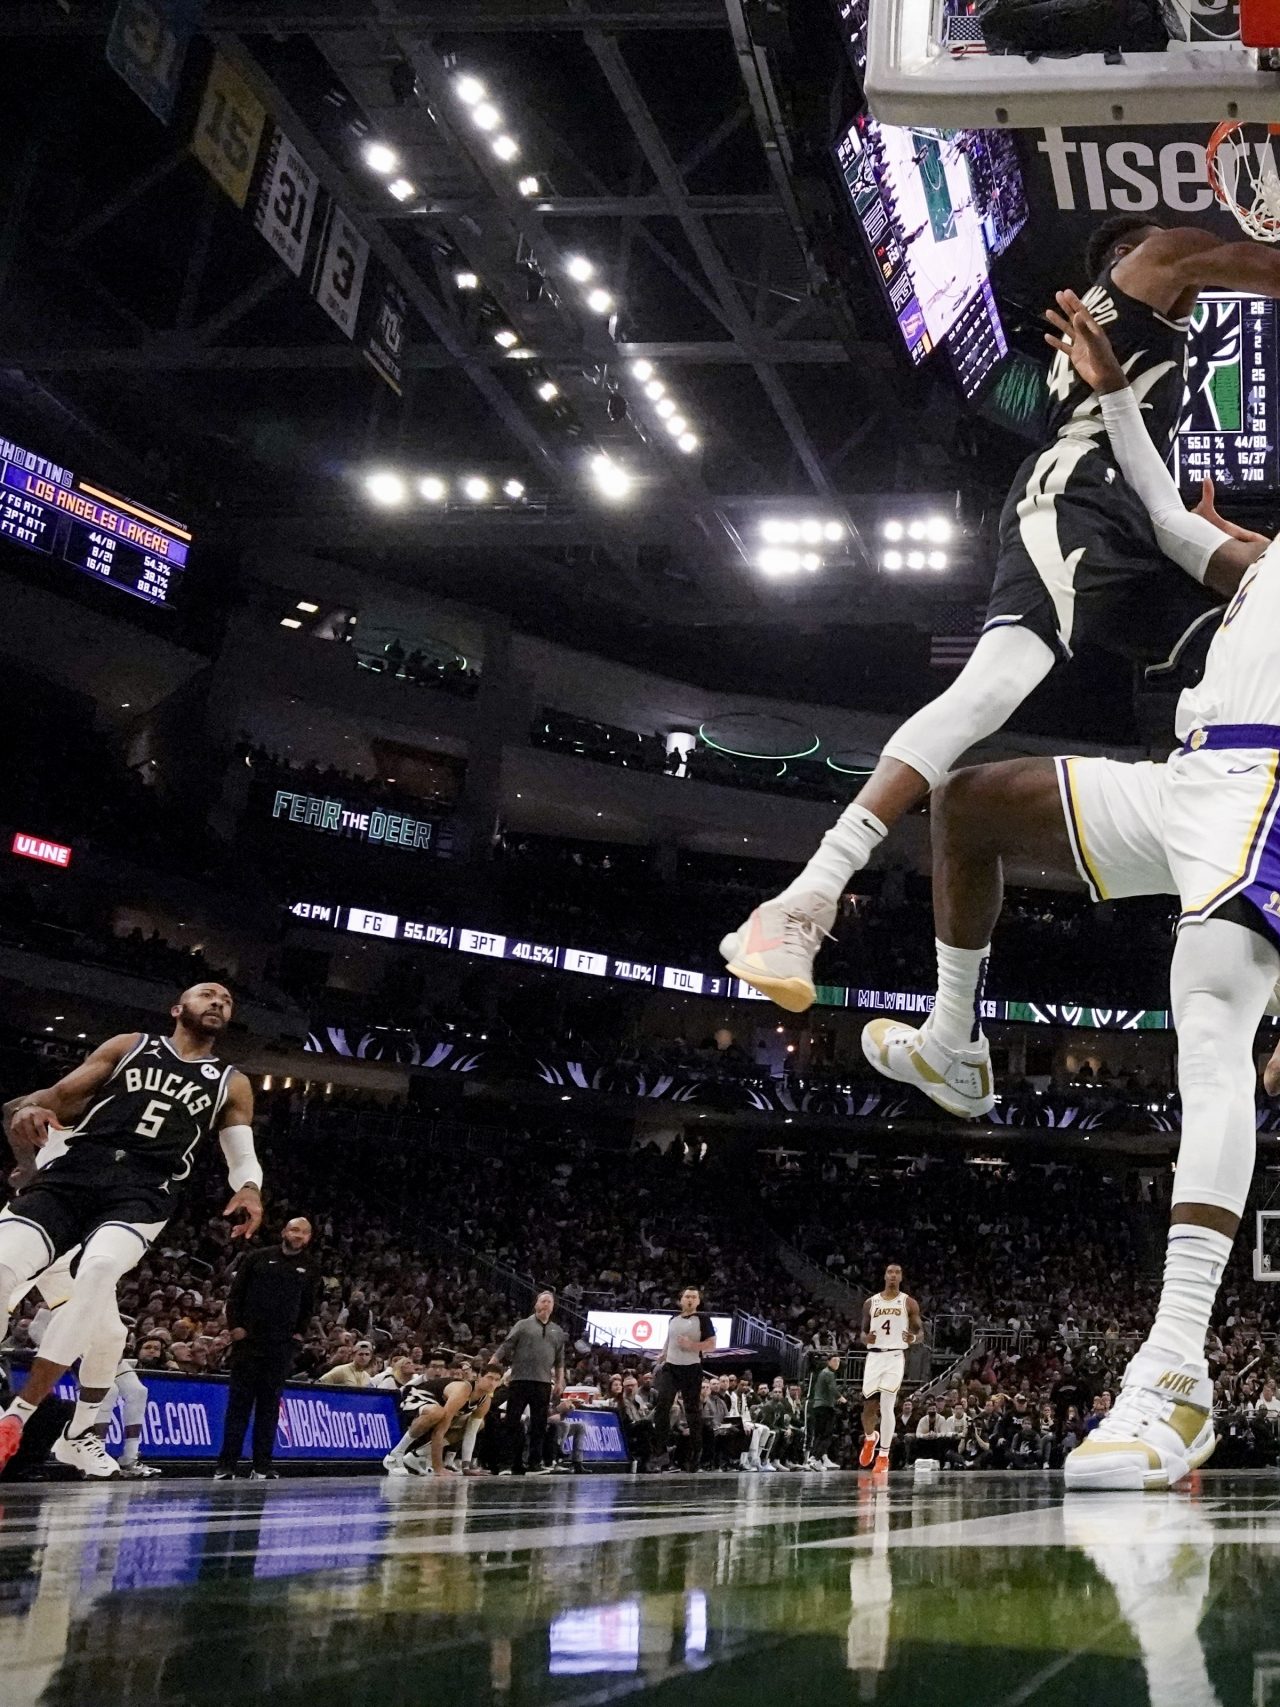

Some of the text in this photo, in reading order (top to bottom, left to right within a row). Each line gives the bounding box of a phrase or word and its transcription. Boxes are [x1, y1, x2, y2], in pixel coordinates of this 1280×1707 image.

[274, 172, 307, 242] 31
[333, 246, 355, 300] 3
[1251, 302, 1264, 314] 26
[1254, 319, 1261, 331] 4
[1254, 336, 1261, 348] 2
[1255, 352, 1261, 365] 9
[1252, 369, 1265, 381] 25
[1253, 386, 1265, 398] 10
[1253, 402, 1265, 415] 13
[1252, 419, 1266, 431] 20
[1188, 436, 1210, 449] 55.0
[1215, 436, 1224, 448] %
[1234, 436, 1266, 448] 44/80
[1188, 453, 1210, 465] 40.5
[1215, 453, 1224, 465] %
[1238, 452, 1266, 464] 15/37
[1215, 469, 1225, 481] %
[1242, 469, 1264, 480] 7/10
[26, 476, 169, 555] LOS ANGELES LAKERS
[8, 494, 170, 576] FG ATT 44/81 54.3%
[4, 507, 168, 588] 3PT ATT 8/21 38.1%
[1, 520, 166, 600] FT ATT 16/18 88.9%
[273, 790, 432, 849] FEAR THE DEER
[17, 836, 68, 863] ULINE
[312, 907, 331, 921] PM
[363, 914, 720, 994] FG 55.0% 3PT 40.5% FT 70.0% TOL 3
[857, 989, 936, 1013] MILWAUKE
[125, 1068, 212, 1116] BUCKS
[135, 1100, 171, 1138] 5
[881, 1320, 890, 1335] 4
[1155, 1370, 1200, 1397] NIKE
[286, 1399, 392, 1449] NBAStore.com
